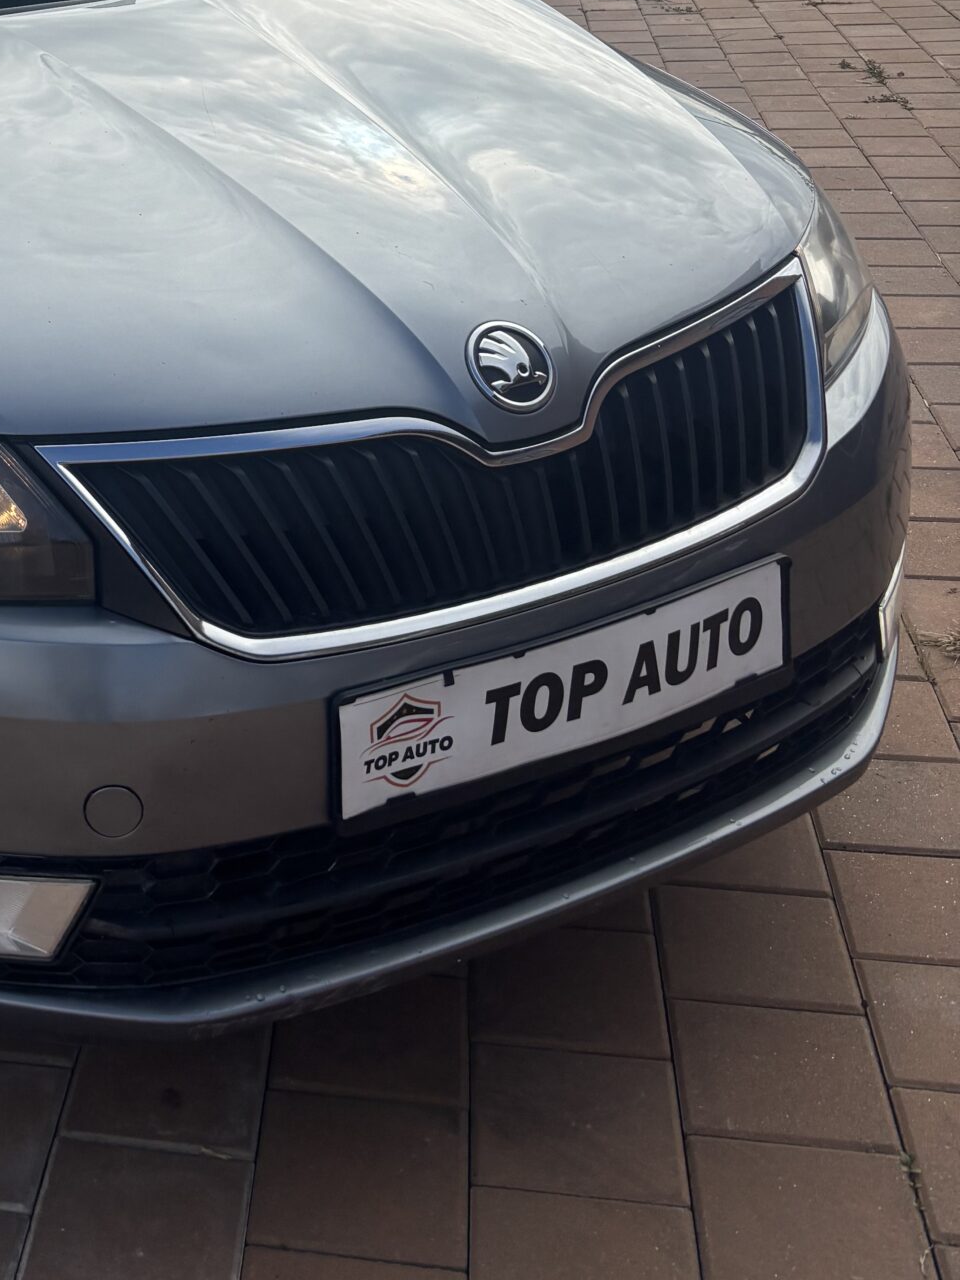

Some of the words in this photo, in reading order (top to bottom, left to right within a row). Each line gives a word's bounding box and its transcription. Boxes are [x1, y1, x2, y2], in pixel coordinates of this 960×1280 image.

[485, 658, 608, 746] TOP
[623, 596, 763, 706] AUTO
[363, 750, 400, 775] TOP
[401, 735, 454, 763] AUTO
